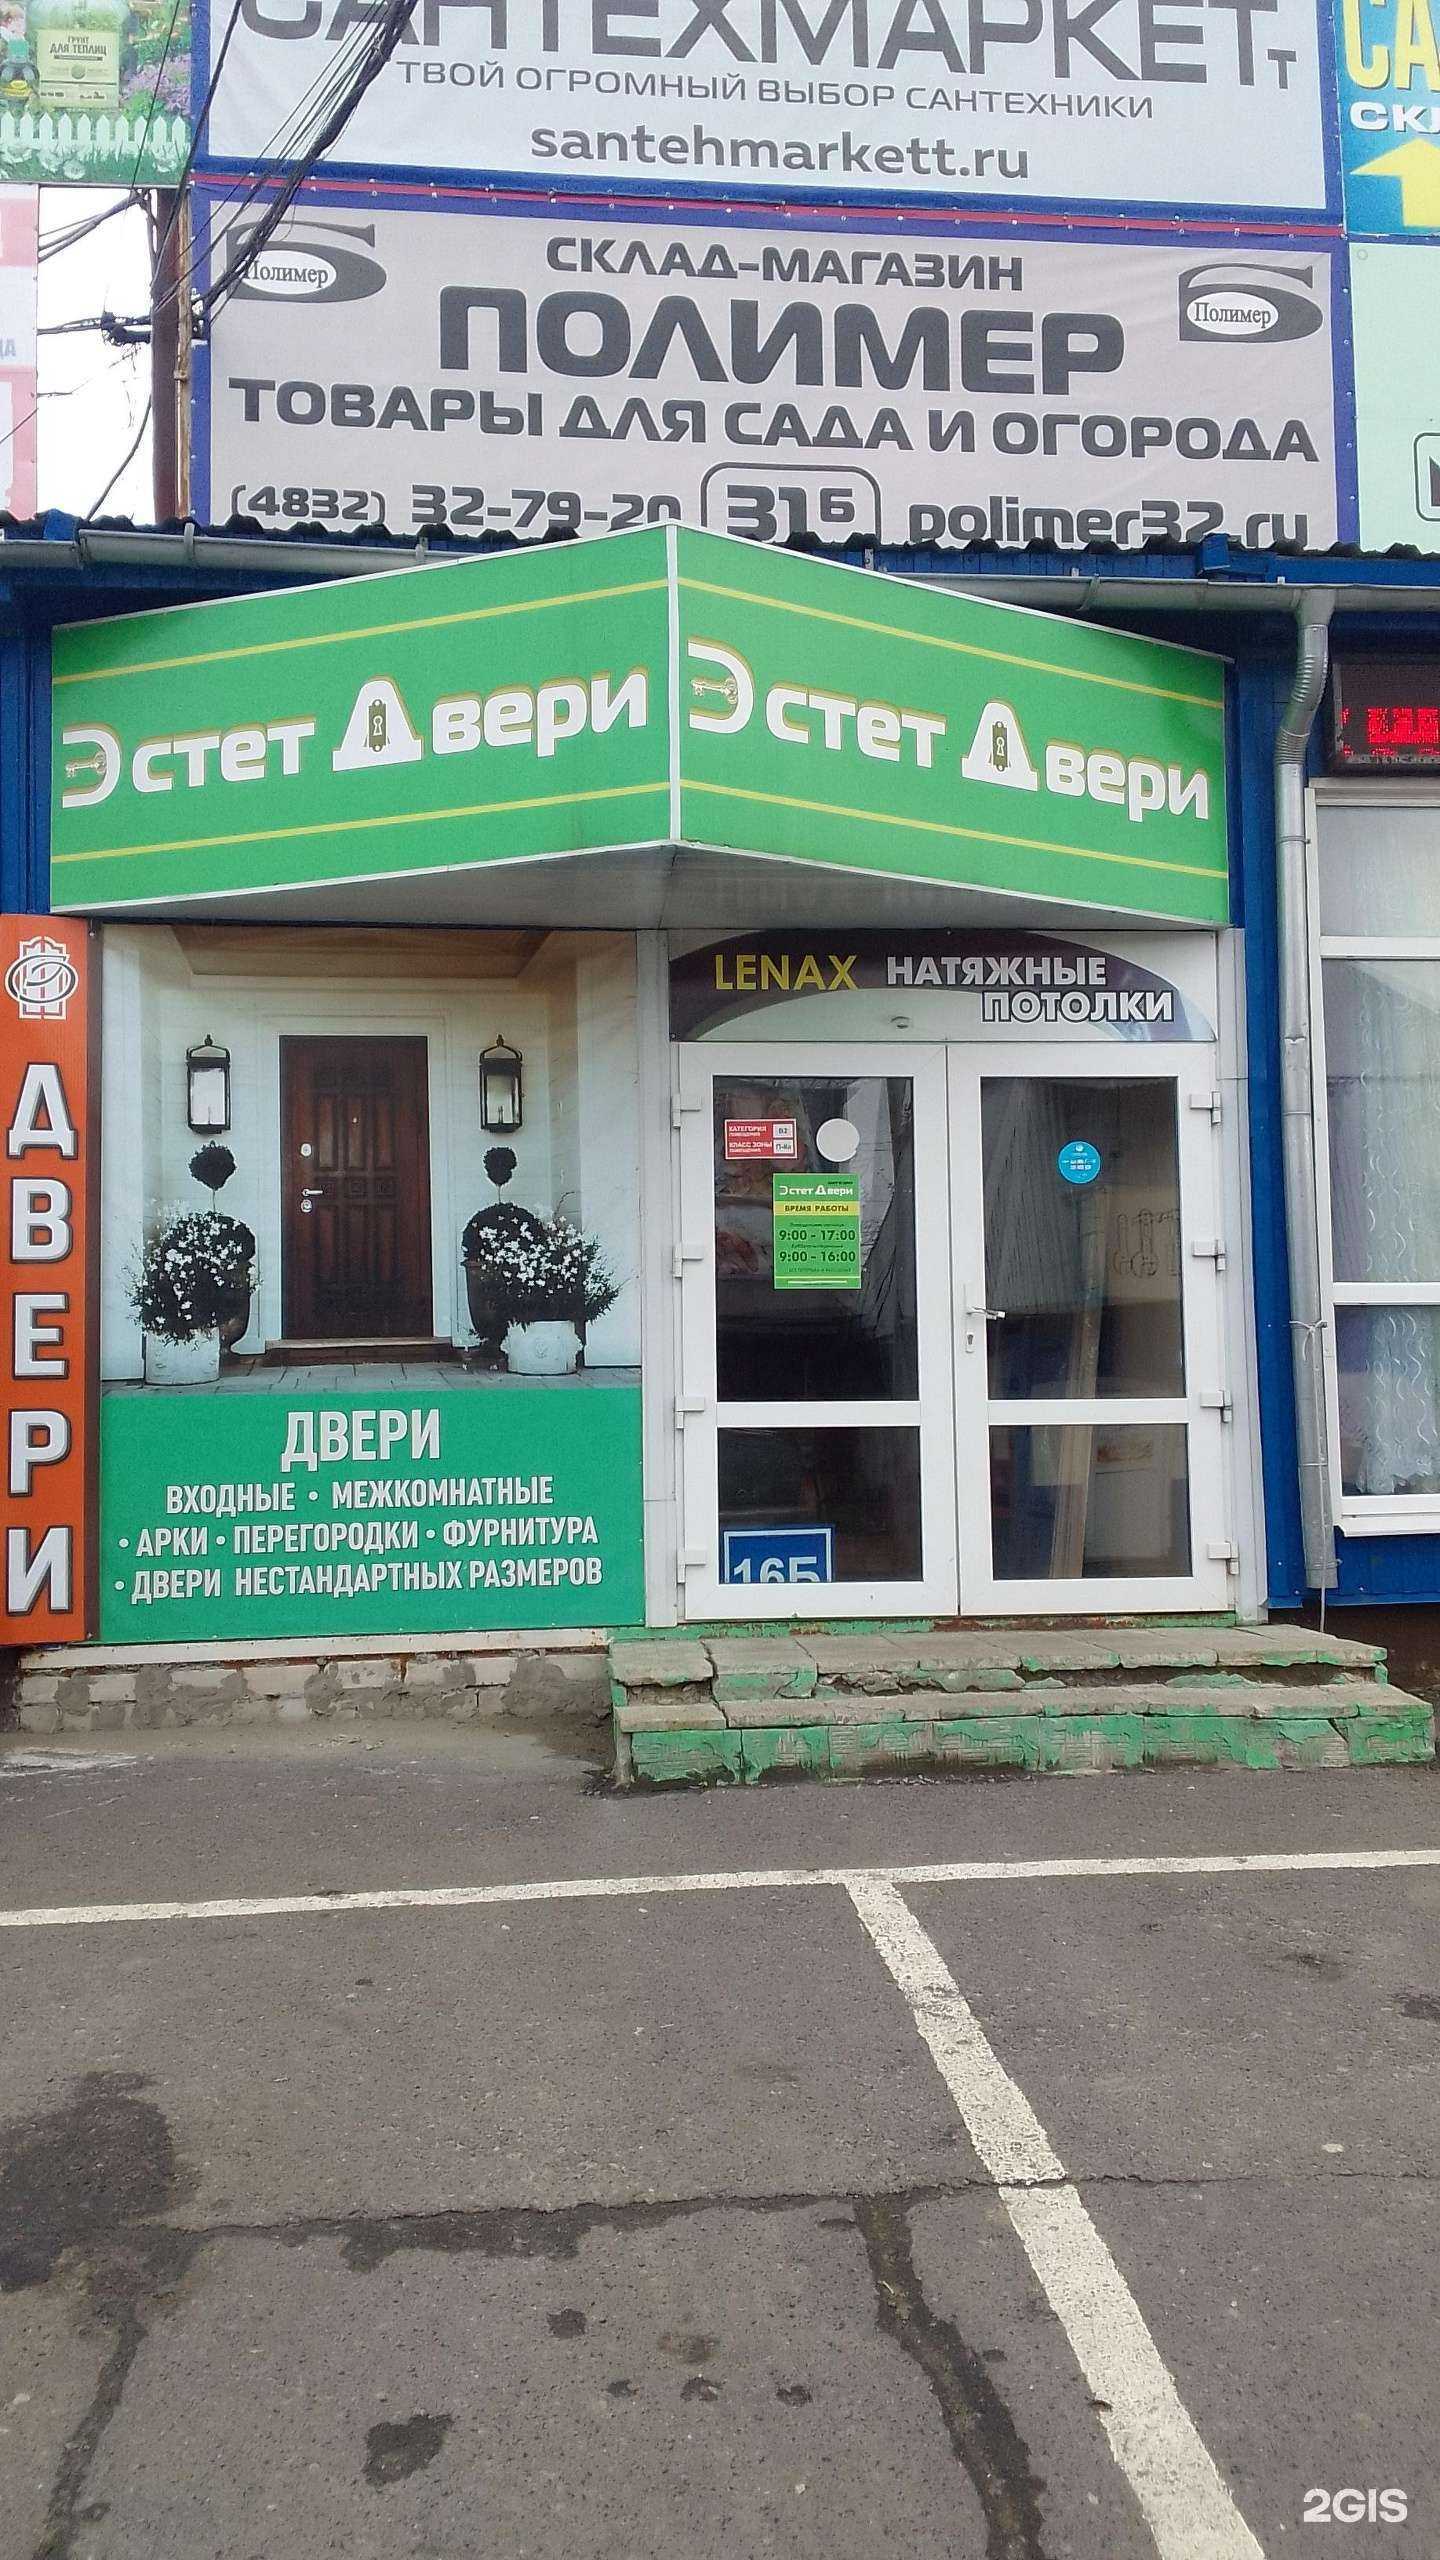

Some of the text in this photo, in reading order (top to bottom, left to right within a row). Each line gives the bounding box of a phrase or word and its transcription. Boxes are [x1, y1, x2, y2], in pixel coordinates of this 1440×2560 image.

[50, 43, 107, 56] ДЛЯ ТЕПЛИЦ
[396, 60, 1153, 118] ТВОЙ ОГРОМНЫЙ ВЫБОР САНТЕХНИКИ
[531, 125, 1028, 179] santehmarkett.ru
[244, 261, 328, 288] Полимер
[546, 236, 1023, 291] СКЛАД-МАГАЗИН
[1194, 302, 1271, 329] Полимер
[440, 286, 1125, 395] ПОЛИМЕР
[228, 377, 1320, 463] ТОВАРЫ ДЛЯ САДА И ОГОРОДА
[231, 484, 682, 530] (4832) 32-79-20
[909, 495, 1308, 548] polimer32.ru
[62, 666, 648, 808] Эстет Двери
[687, 638, 1210, 822] Эстет Двери
[715, 955, 858, 991] LENAX
[886, 956, 1107, 986] НАТЯЖНЫЕ
[981, 991, 1175, 1023] ПОТОЛКИ
[779, 1184, 853, 1197] Эстет Двери
[779, 1229, 807, 1241] 9:00
[820, 1229, 856, 1241] 17:00
[779, 1251, 808, 1262] 9:00
[820, 1251, 856, 1262] 16:00
[7, 1063, 78, 1615] ДВЕРИ
[280, 1408, 441, 1472] ДВЕРИ
[166, 1476, 554, 1518] ВХОДНЫЕ МЕЖКОМНАТНЫЕ
[136, 1516, 599, 1557] АРКИ ПЕРЕГОРОДКИ ФУРНИТУРА
[131, 1557, 603, 1604] ДВЕРИ НЕСТАНДАРТНЫХ РАЗМЕРОВ
